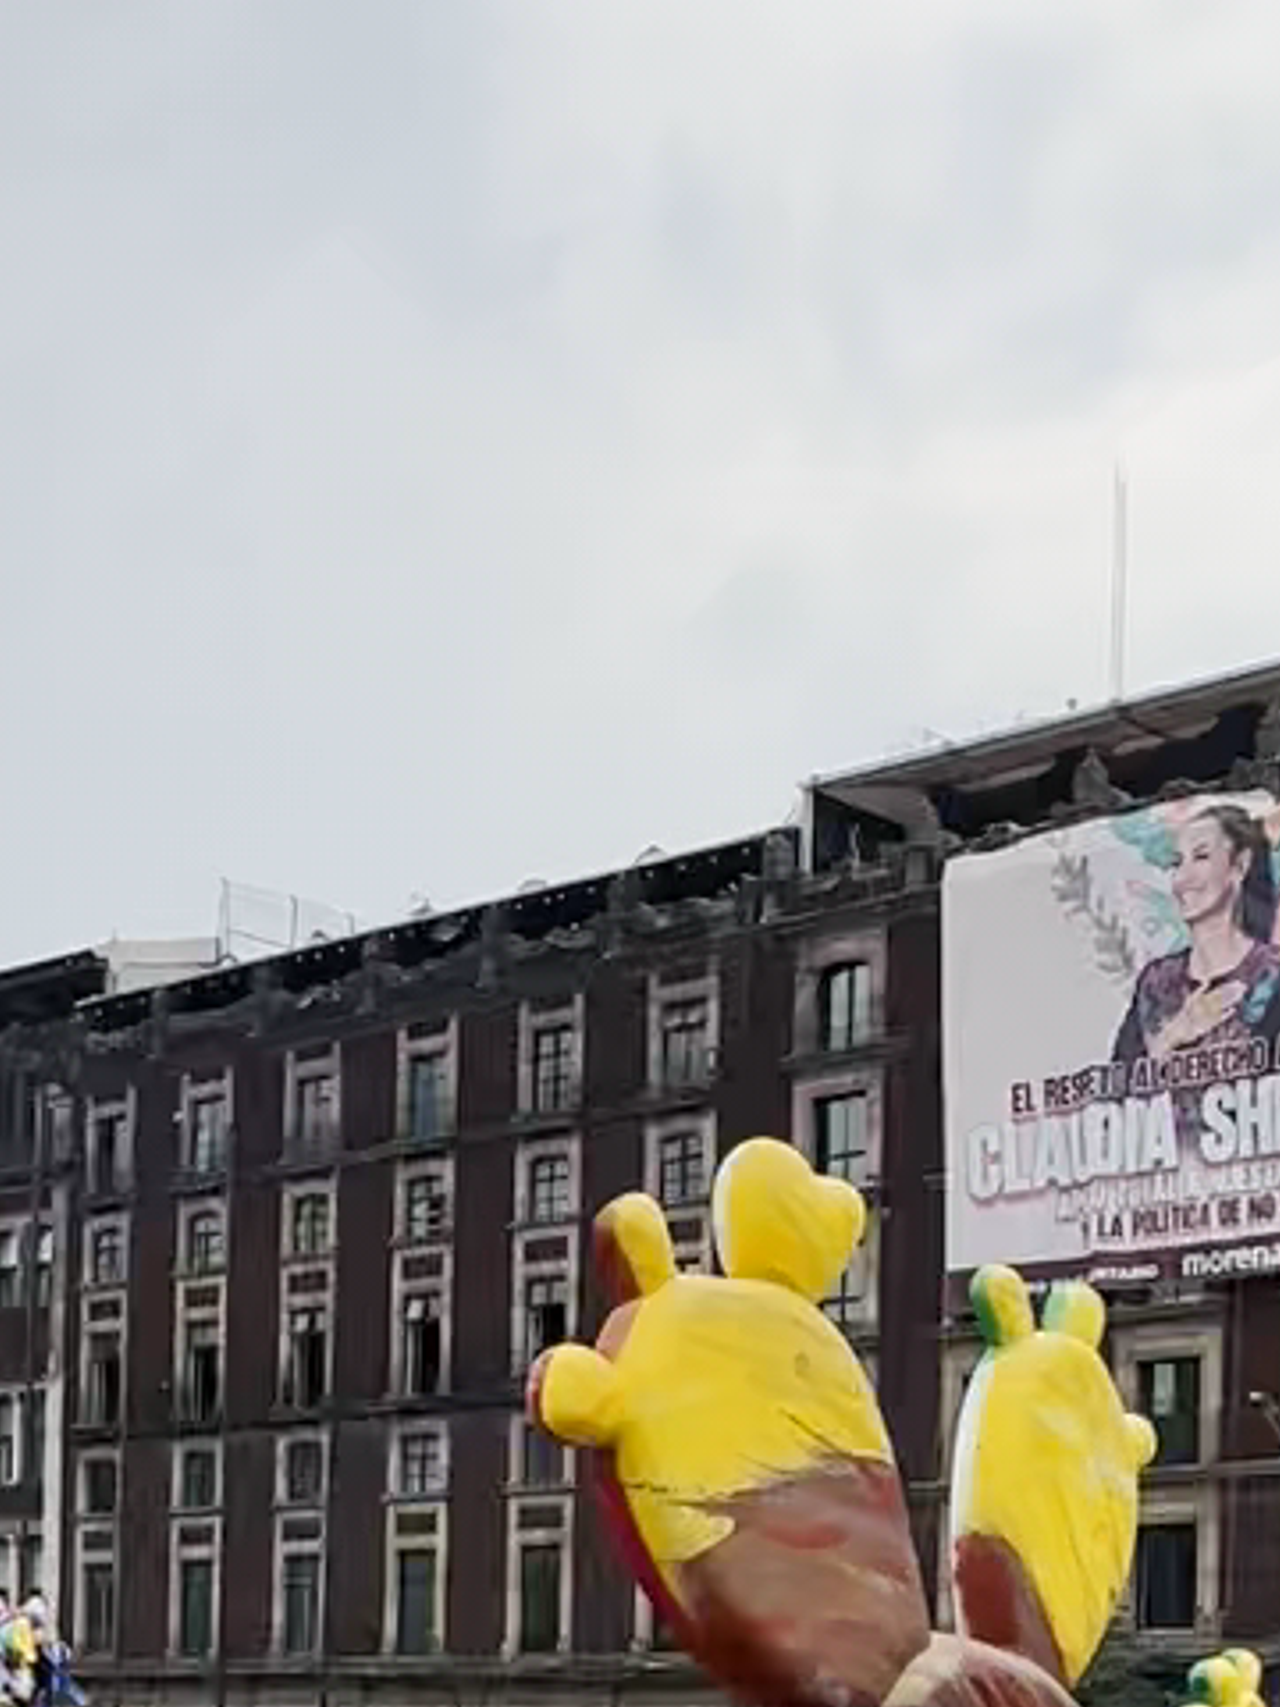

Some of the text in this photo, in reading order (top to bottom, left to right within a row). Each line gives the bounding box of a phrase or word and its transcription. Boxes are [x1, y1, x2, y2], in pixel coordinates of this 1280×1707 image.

[1010, 1081, 1036, 1114] EL
[1170, 1038, 1269, 1084] DERECHO
[968, 1093, 1178, 1200] CLAUDIA
